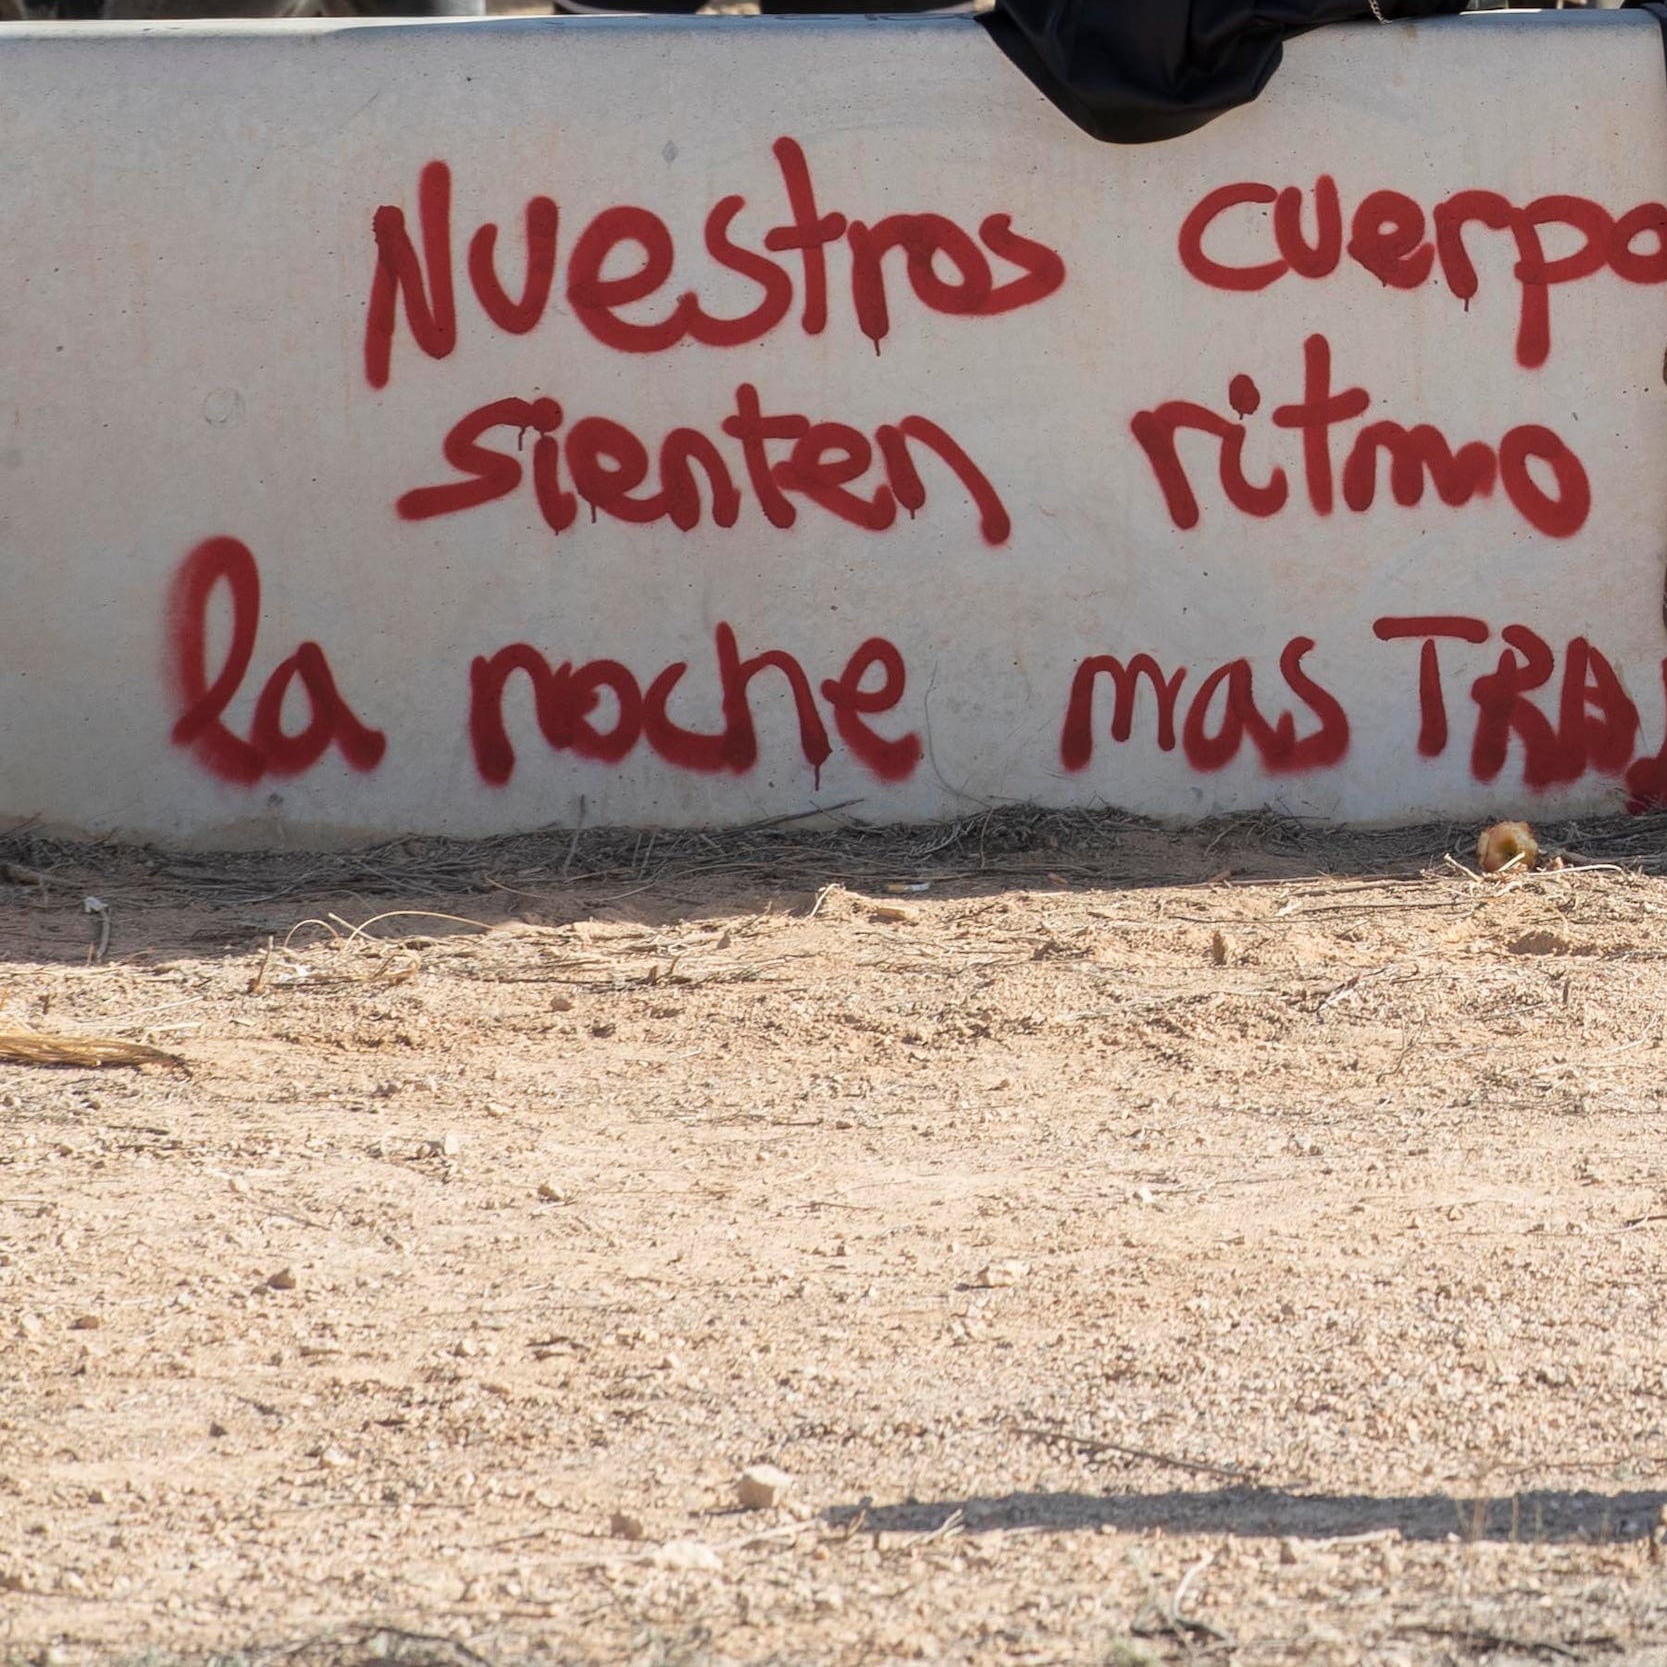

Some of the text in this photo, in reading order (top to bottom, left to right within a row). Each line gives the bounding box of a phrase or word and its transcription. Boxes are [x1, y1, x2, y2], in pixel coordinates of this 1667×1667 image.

[363, 136, 1067, 390] Nuestros
[395, 383, 1012, 546] sienten
[1128, 333, 1591, 539] ritmo
[168, 536, 386, 787] la
[468, 622, 922, 789] noche
